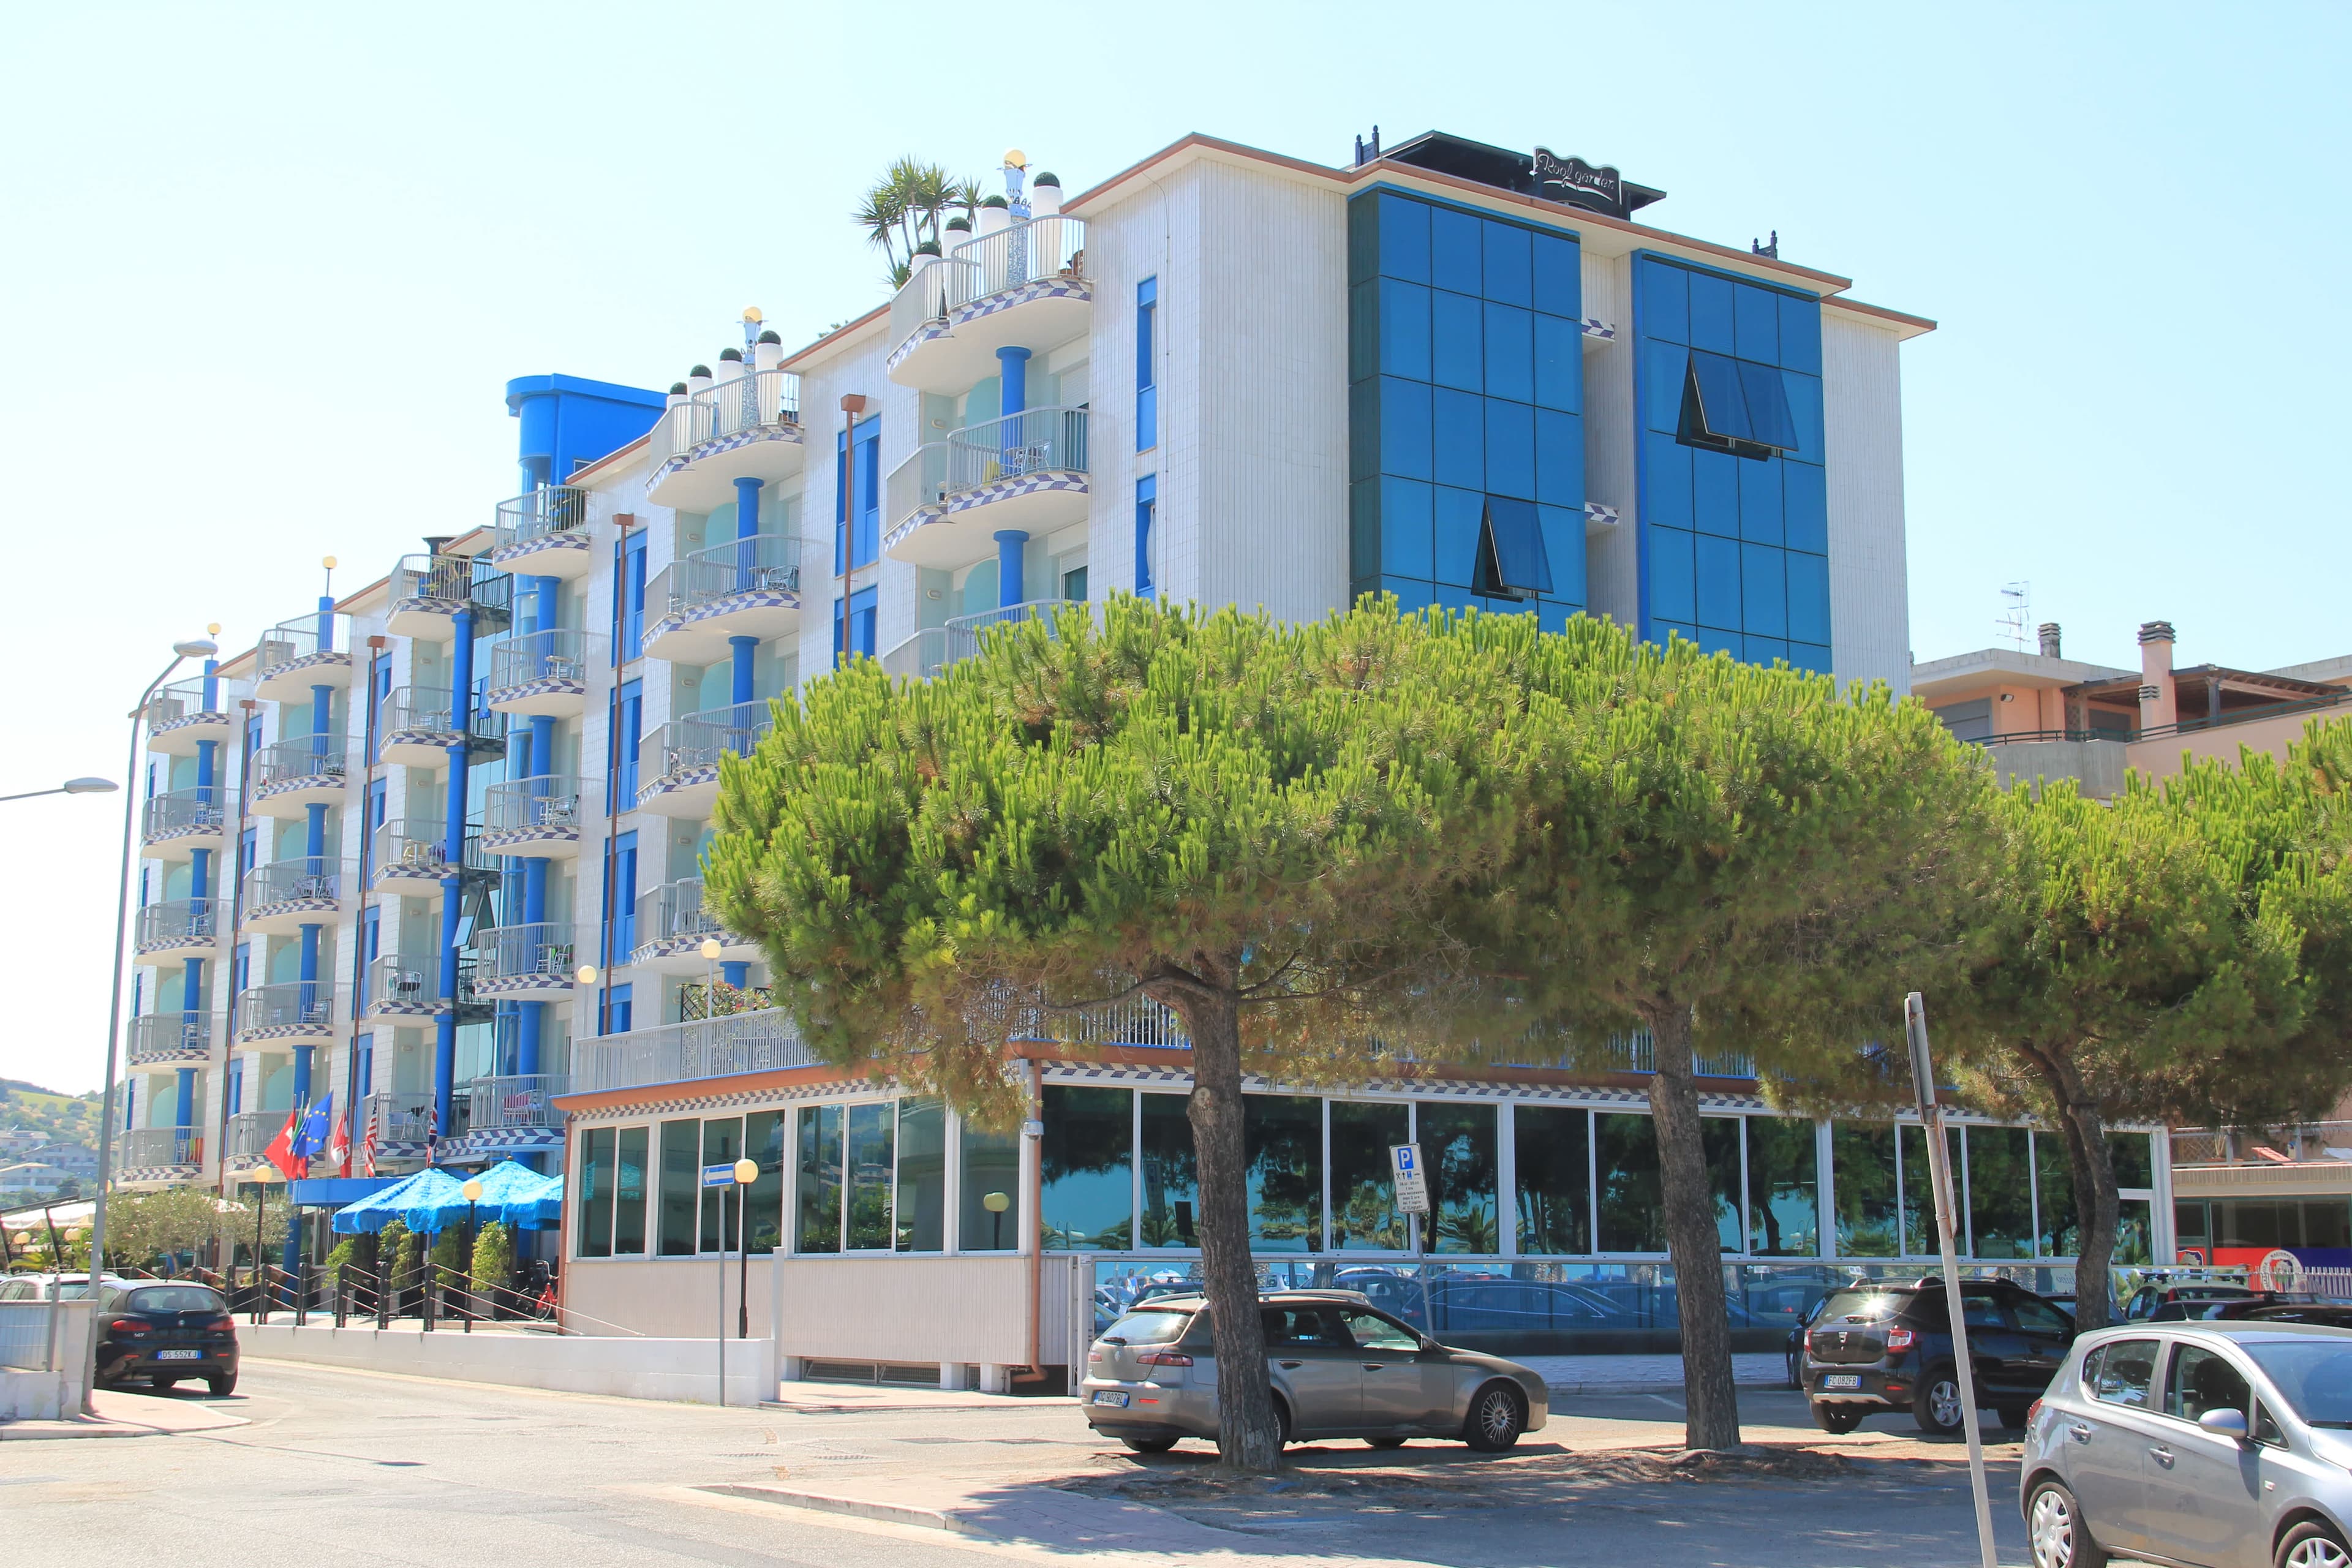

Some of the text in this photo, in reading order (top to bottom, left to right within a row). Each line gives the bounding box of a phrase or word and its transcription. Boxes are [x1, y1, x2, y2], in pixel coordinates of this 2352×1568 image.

[1537, 153, 1615, 190] Roof garden
[1400, 1150, 1410, 1168] P
[1838, 1376, 1856, 1385] 082FB
